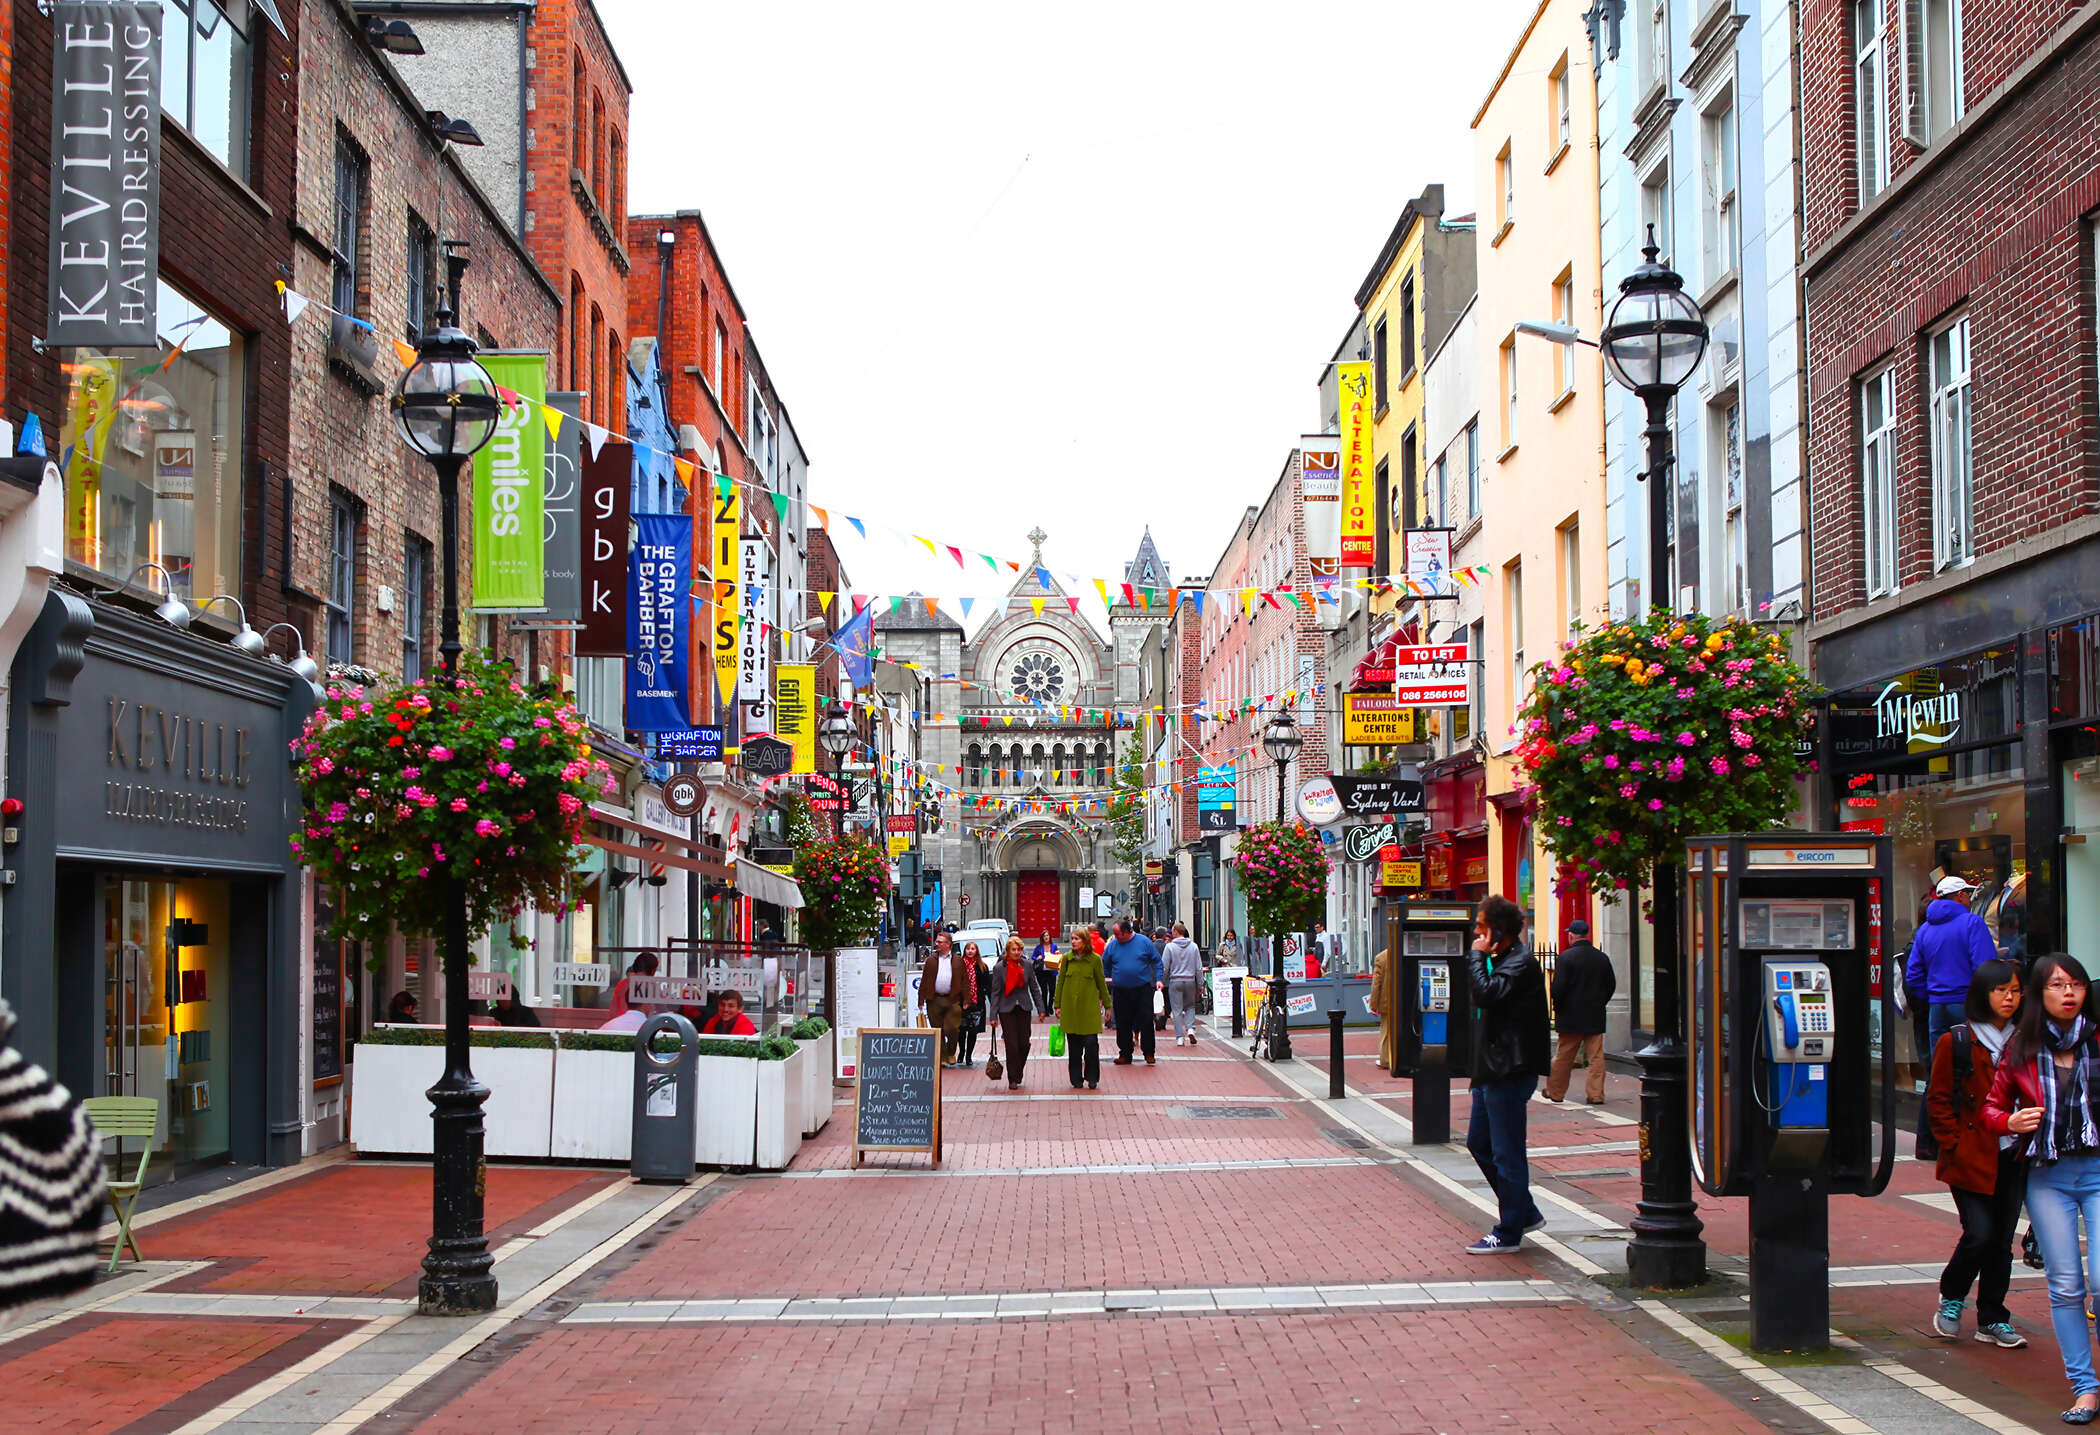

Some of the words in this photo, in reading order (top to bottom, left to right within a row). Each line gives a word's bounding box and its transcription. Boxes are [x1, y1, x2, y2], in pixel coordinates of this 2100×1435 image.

[58, 22, 114, 327] KEVILLE
[119, 24, 152, 326] HAIRDRESSING
[491, 400, 530, 536] Smiles
[1350, 401, 1364, 530] ALTERATION
[641, 545, 676, 560] THE
[1342, 541, 1372, 552] CENTRE
[639, 562, 656, 651] BARBER
[658, 562, 677, 665] GRAFTON
[716, 655, 737, 669] HEMS
[1412, 650, 1429, 661] TO
[1431, 648, 1456, 660] LET
[1400, 671, 1426, 680] RETAIL
[636, 690, 678, 698] BASEMENT
[1402, 691, 1421, 701] 086
[1423, 689, 1467, 700] 2566106
[778, 679, 806, 735] GOTHAM
[1351, 713, 1411, 723] ALTERATIONS
[672, 730, 722, 741] GRAFTON
[1363, 724, 1398, 734] CENTRE
[106, 695, 250, 786] KEVILLE
[661, 733, 673, 755] THE
[745, 745, 788, 769] EAT
[674, 788, 694, 800] gbk
[1356, 783, 1378, 791] FURS
[1380, 783, 1392, 791] BY
[1346, 792, 1390, 813] Sydney
[1391, 790, 1422, 807] Vard
[633, 981, 702, 1001] KITCHEN
[870, 1037, 927, 1055] KITCHEN
[861, 1063, 893, 1081] LUNCH
[896, 1062, 934, 1082] SERVED
[867, 1102, 891, 1114] DAILY
[894, 1101, 931, 1115] SPECIALS
